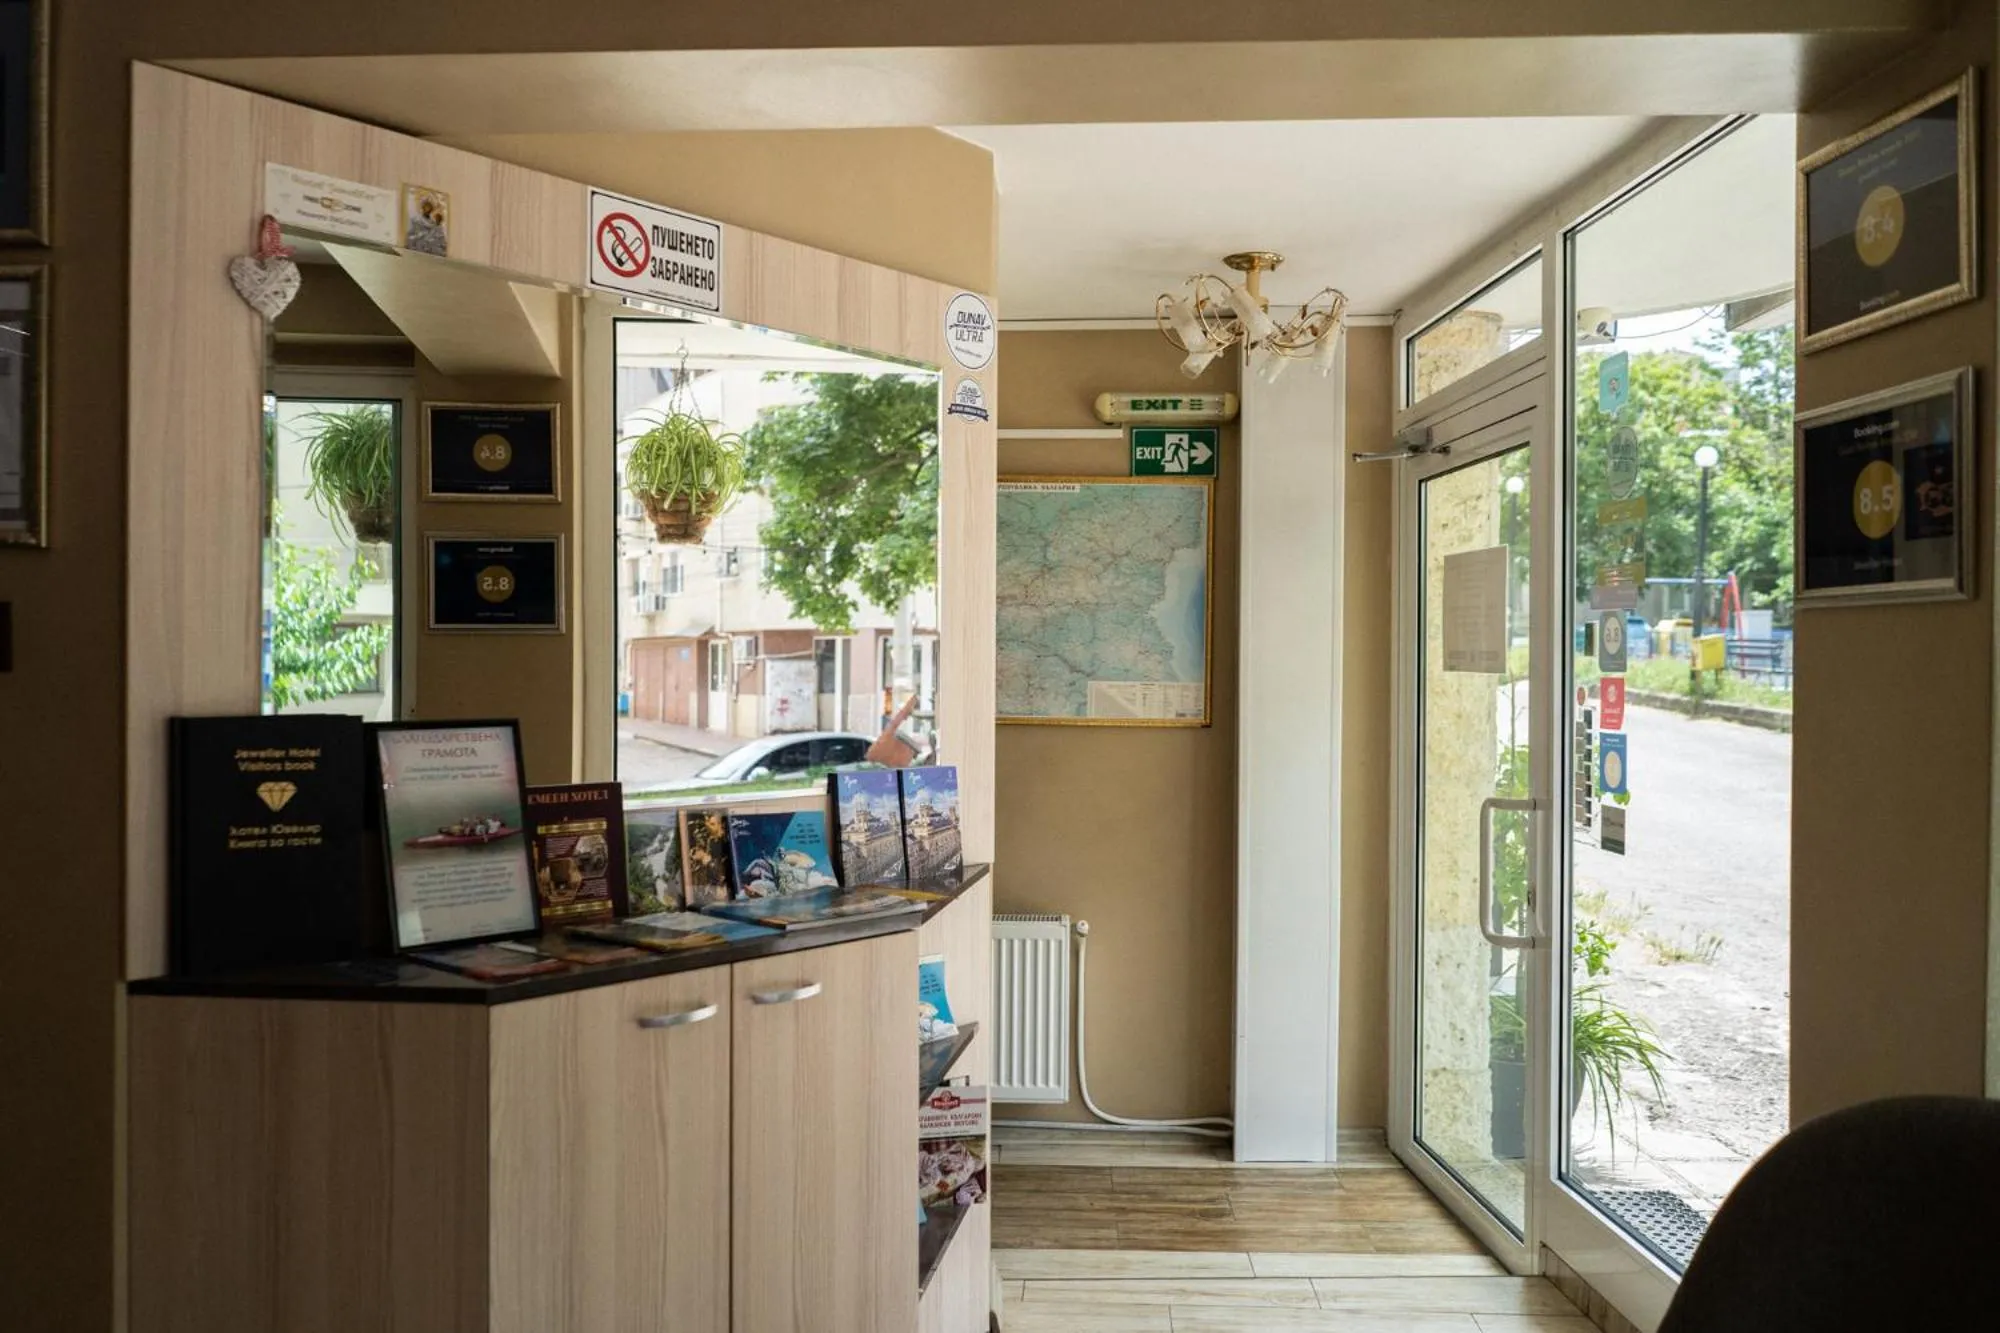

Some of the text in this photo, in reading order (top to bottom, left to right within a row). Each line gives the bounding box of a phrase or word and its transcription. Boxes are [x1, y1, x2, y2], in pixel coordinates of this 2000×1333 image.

[652, 224, 715, 260] ПУШЕНЕТО
[650, 256, 715, 291] ЗАБРАНЕНО
[957, 311, 986, 325] DUNAV
[956, 328, 984, 342] ULTRA
[1130, 399, 1182, 411] EXIT
[1136, 446, 1162, 459] EXIT
[1860, 484, 1894, 515] 8.5
[288, 747, 321, 758] Hotel
[421, 747, 478, 758] ГРАМОТА
[237, 760, 315, 771] Visitors book
[571, 789, 609, 802] ХОТЕЛ
[229, 824, 322, 836] Хотел Ювелир
[229, 837, 322, 849] Книга за гости
